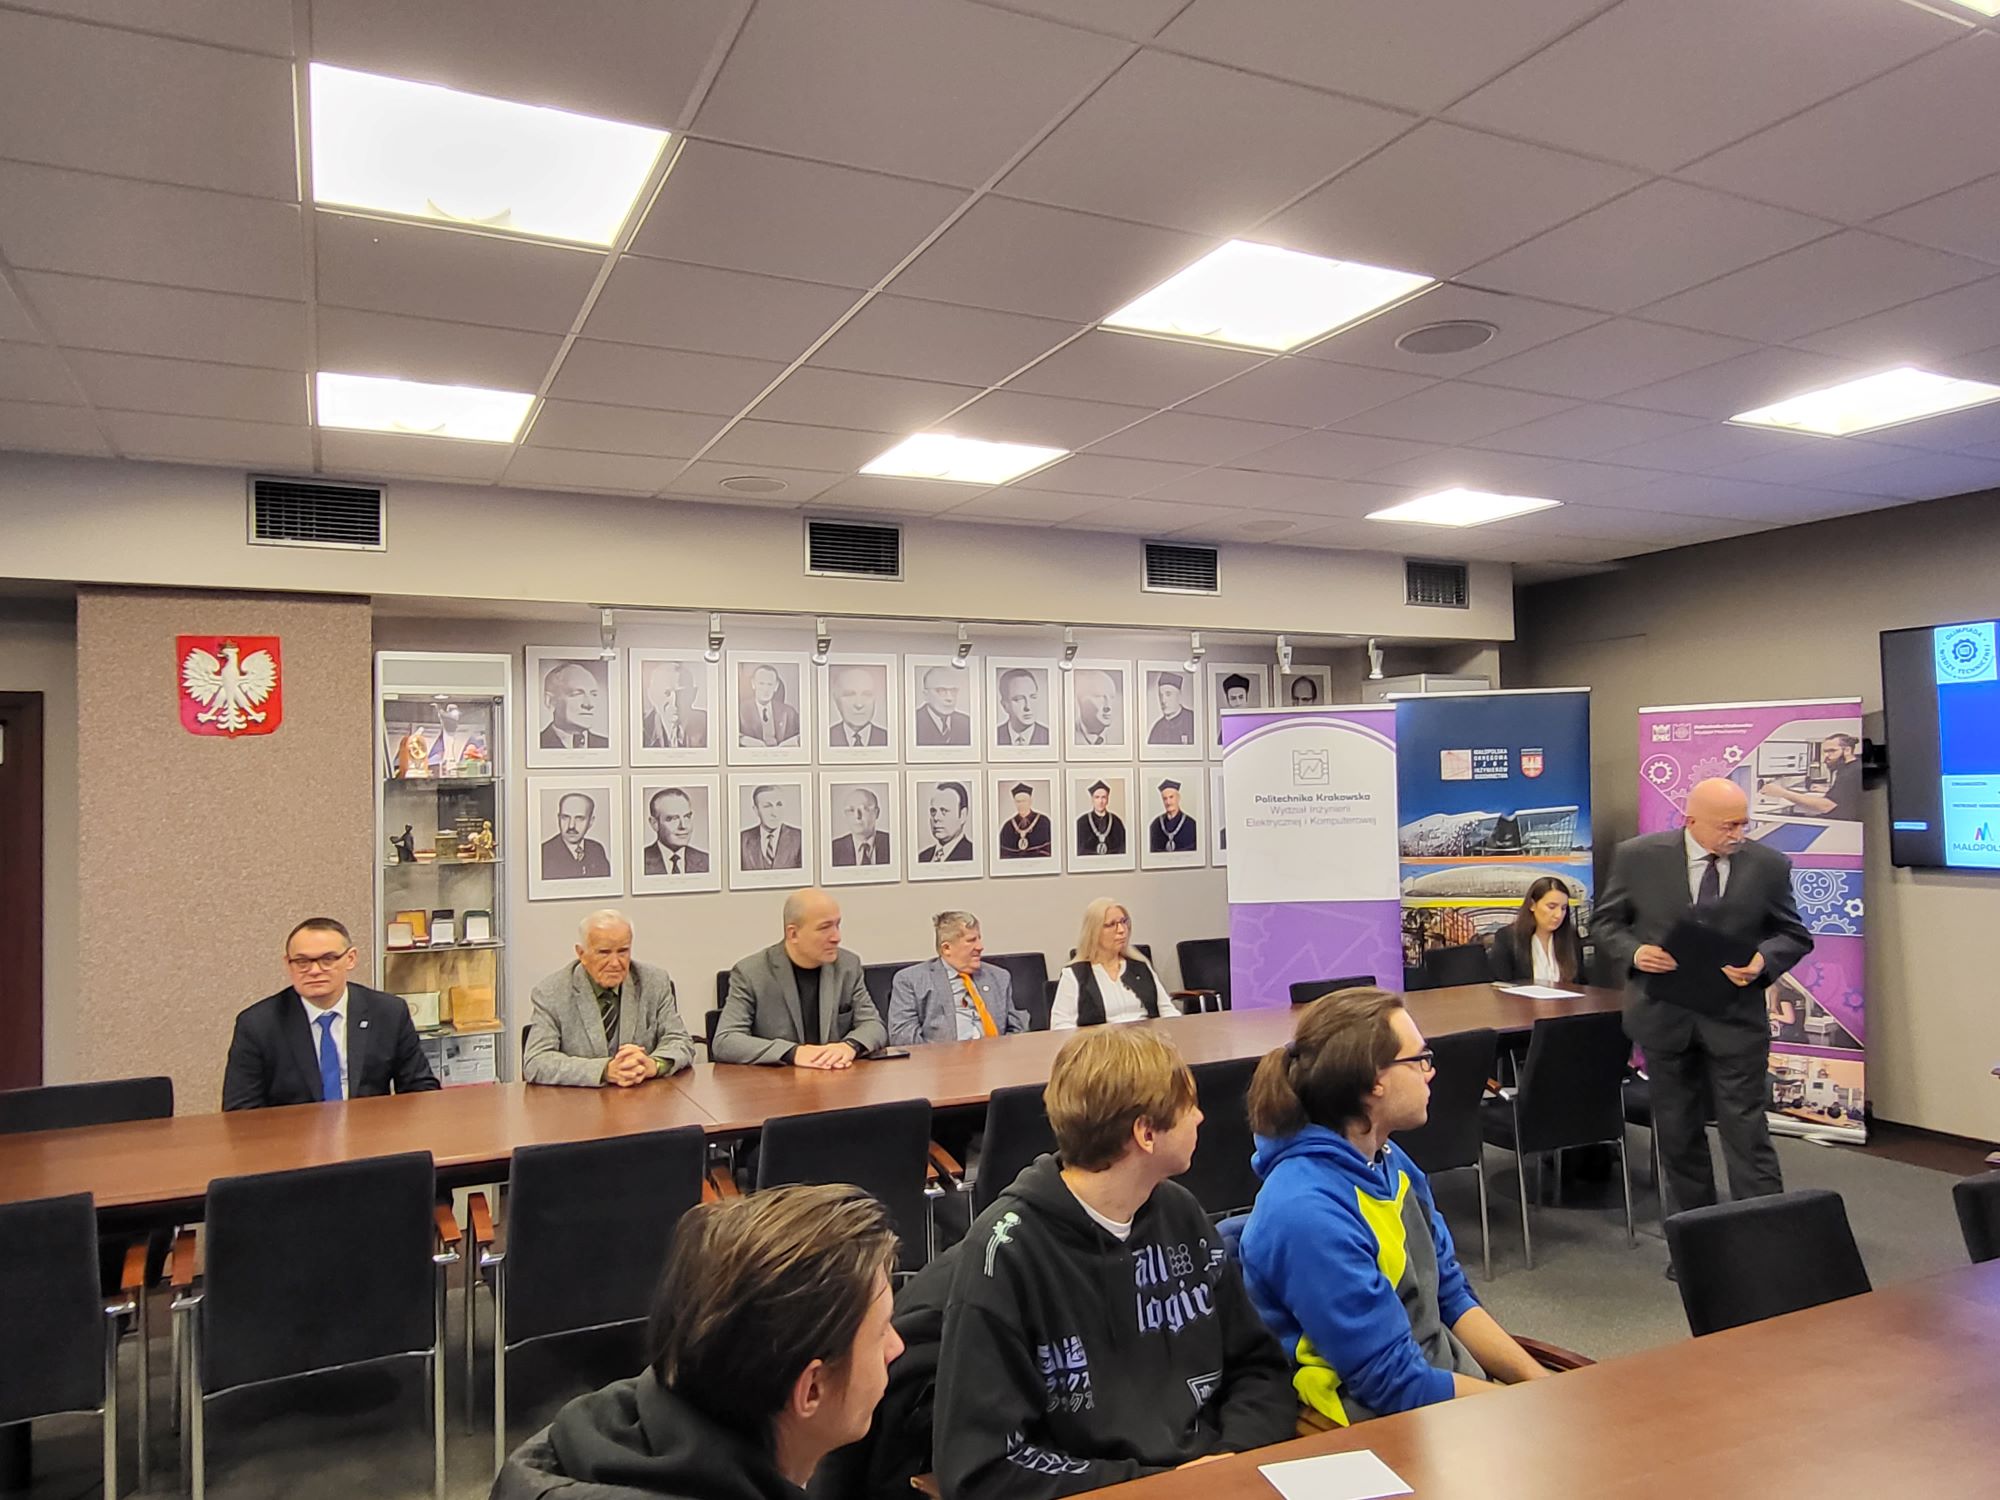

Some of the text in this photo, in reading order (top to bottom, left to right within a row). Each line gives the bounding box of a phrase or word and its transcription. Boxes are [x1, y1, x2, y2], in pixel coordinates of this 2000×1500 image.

[1255, 792, 1371, 803] Politechnika Krakowska
[1270, 806, 1307, 816] Wydział
